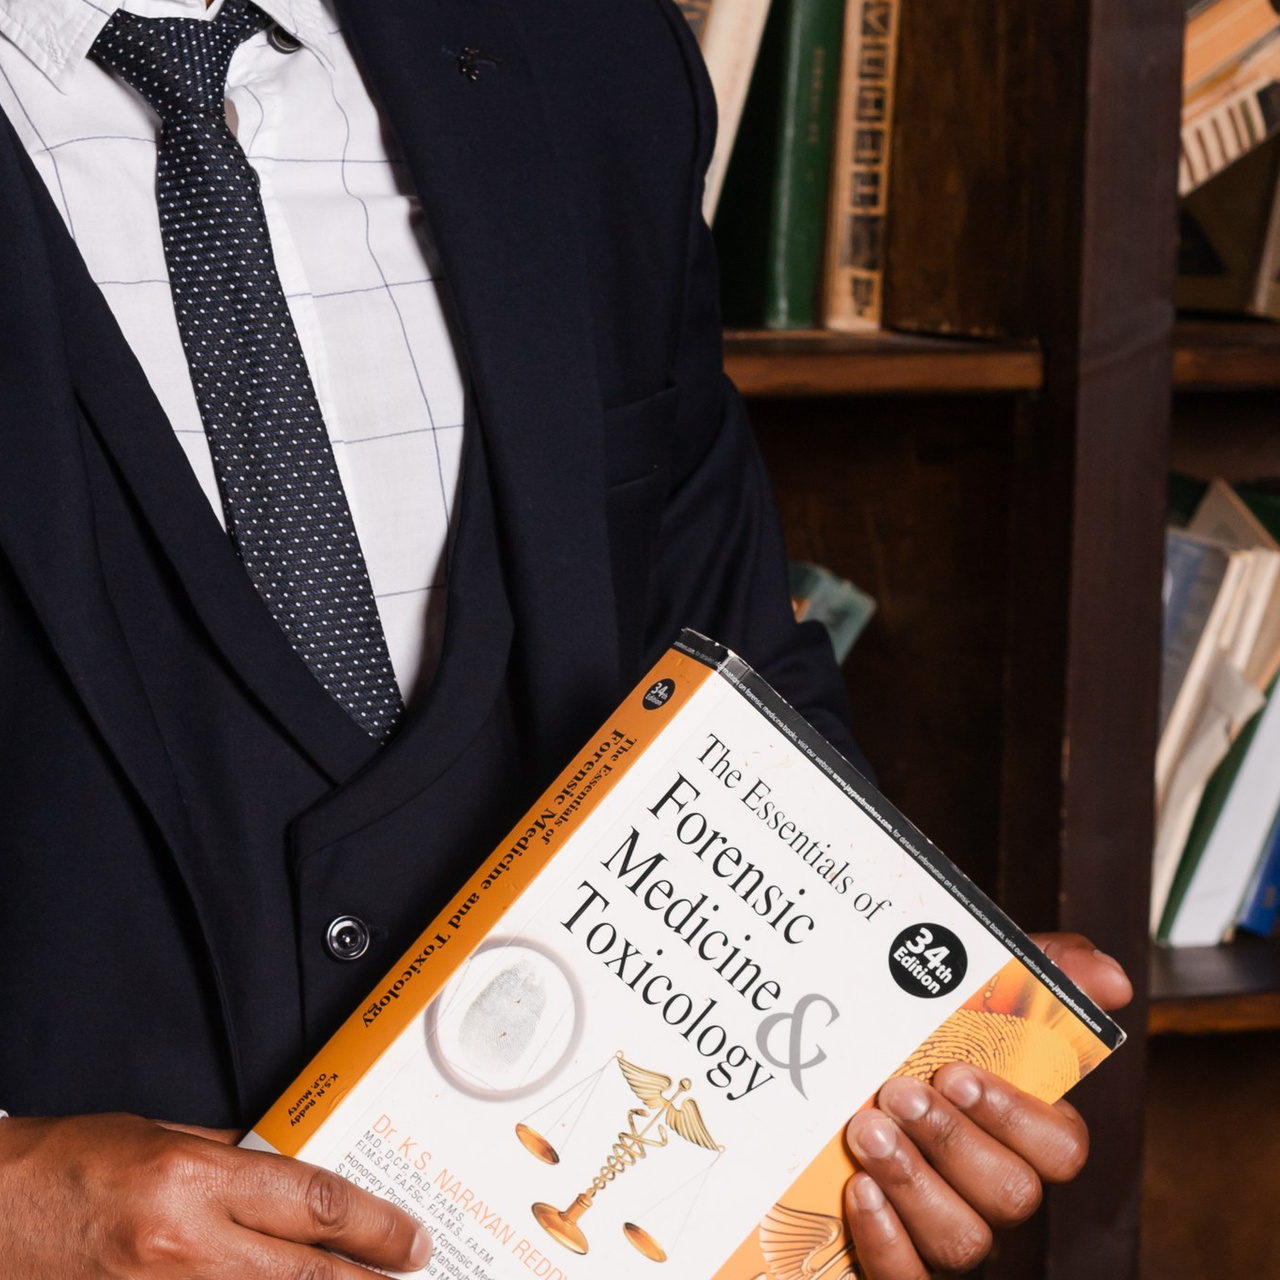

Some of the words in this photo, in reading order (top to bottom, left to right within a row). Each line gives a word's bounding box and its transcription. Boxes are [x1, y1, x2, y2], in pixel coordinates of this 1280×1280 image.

[645, 692, 662, 705] Edition
[650, 679, 674, 699] 34th
[553, 729, 625, 804] Forensic
[610, 738, 637, 761] The
[554, 763, 612, 826] Essentials
[697, 733, 741, 788] The
[740, 778, 853, 893] Essentials
[853, 892, 892, 920] of
[480, 808, 556, 889] Medicine
[541, 828, 554, 845] of
[648, 773, 813, 943] Forensic
[736, 681, 749, 693] on
[743, 687, 765, 709] forensic
[760, 703, 786, 729] medicine
[795, 737, 810, 752] visit
[804, 746, 818, 759] our
[813, 754, 836, 776] website
[891, 828, 902, 839] for
[897, 834, 921, 858] detailed
[916, 852, 947, 883] information
[942, 877, 954, 889] on
[949, 883, 972, 906] forensic
[967, 900, 993, 927] medicine
[1003, 935, 1017, 950] visit
[1012, 945, 1026, 958] our
[1021, 953, 1044, 976] website
[1038, 970, 1103, 1035] www.jaypeebrothers.com
[447, 892, 479, 929] and
[362, 933, 450, 1027] Toxicology
[601, 827, 780, 1010] Medicine
[755, 993, 839, 1099] &
[893, 946, 940, 993] Edition
[905, 927, 951, 983] 34th
[561, 881, 787, 1100] Toxicology
[287, 1089, 312, 1116] Murty
[290, 1098, 316, 1126] Reddy
[310, 1073, 326, 1089] O.P.
[313, 1072, 338, 1097] K.S.N.
[343, 1151, 385, 1191] Honorary
[382, 1185, 430, 1227] Professor
[424, 1221, 440, 1236] of
[435, 1232, 472, 1268] Forensic
[354, 1139, 390, 1177] F.I.M.S.A.,
[393, 1173, 424, 1208] F.A.F.Sc.,
[426, 1203, 462, 1241] F.I.A.M.S.,
[464, 1236, 493, 1265] F.A.F.M.
[362, 1129, 382, 1153] M.D.,
[384, 1149, 409, 1176] D.C.P.,
[409, 1171, 430, 1197] Ph.D.,
[433, 1192, 464, 1226] F.A.M.S.,
[371, 1113, 397, 1143] Dr.
[397, 1136, 431, 1175] K.S.
[433, 1168, 515, 1245] NARAYAN
